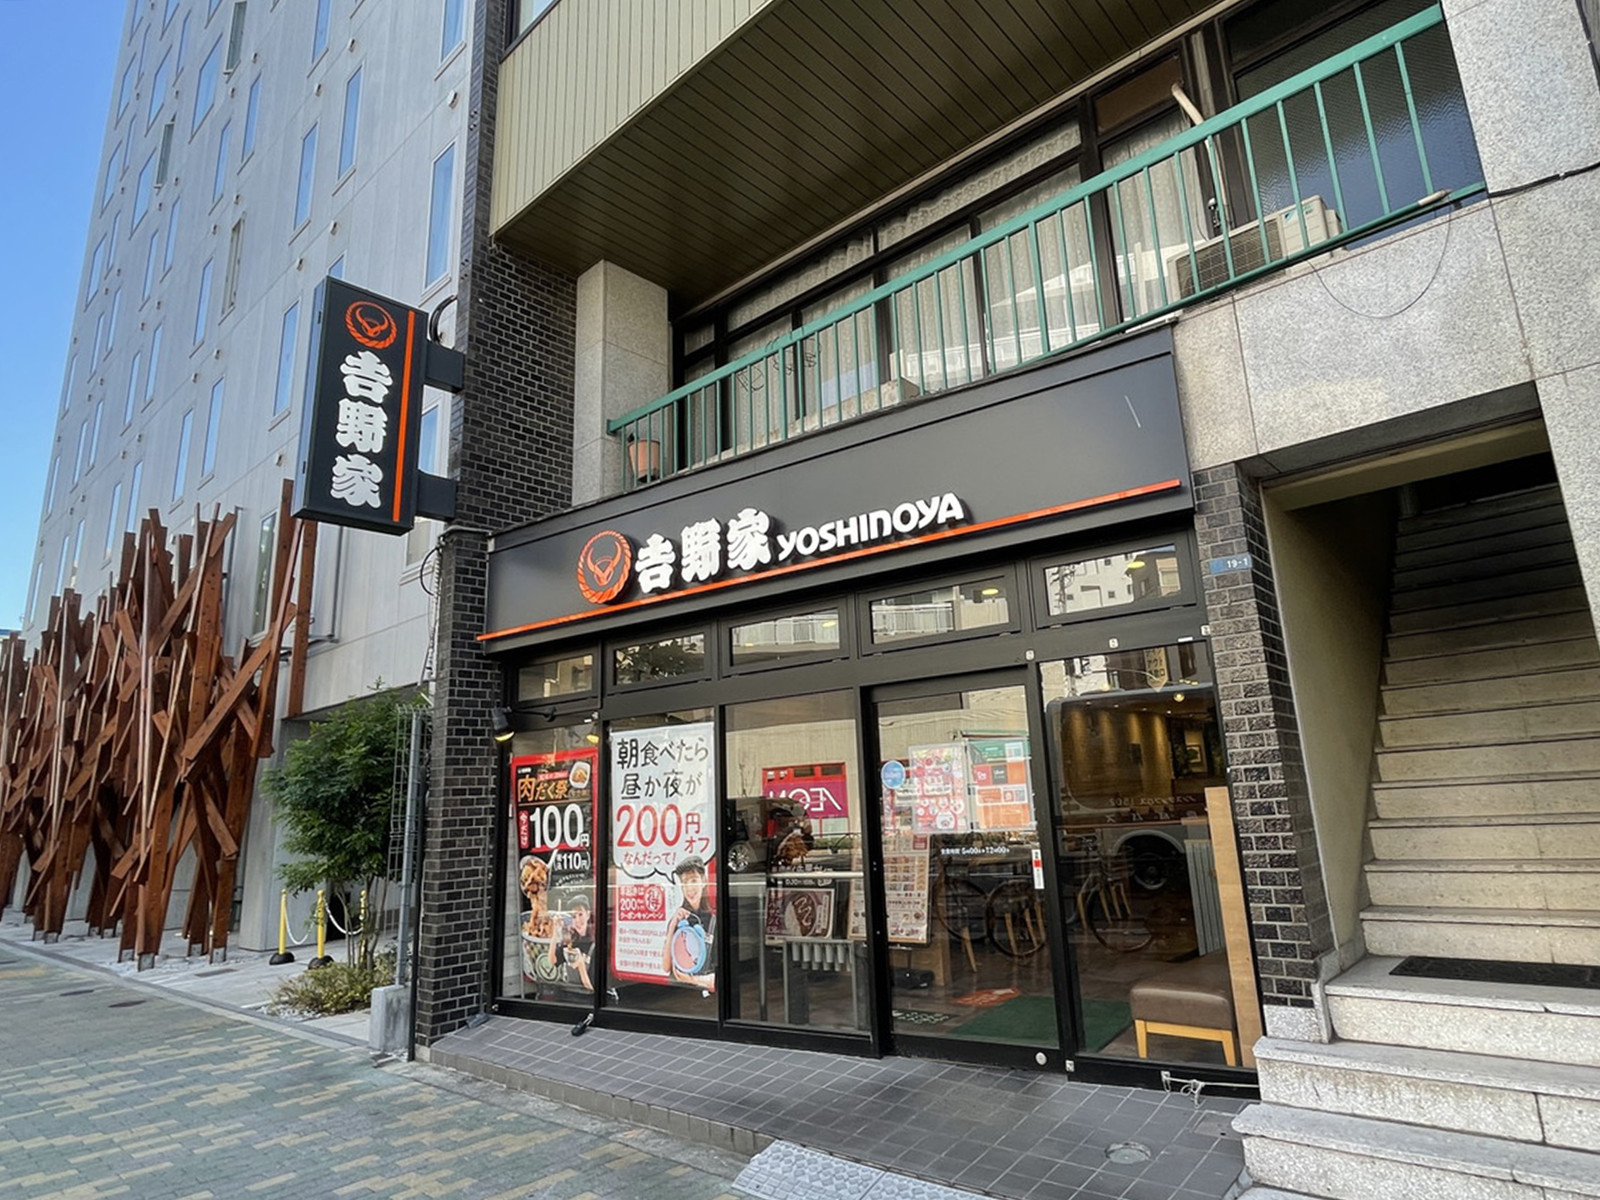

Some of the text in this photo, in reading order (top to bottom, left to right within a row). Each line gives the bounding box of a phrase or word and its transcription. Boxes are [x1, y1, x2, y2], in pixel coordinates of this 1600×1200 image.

[330, 350, 393, 509] 吉野家
[634, 492, 966, 594] 吉野家 YOSHINOYA
[1226, 557, 1249, 569] 19-1
[616, 737, 709, 770] 朝食べたら
[620, 769, 703, 800] 昼か夜が
[529, 803, 590, 849] 100円
[616, 803, 701, 849] 200円
[683, 836, 711, 854] オフ
